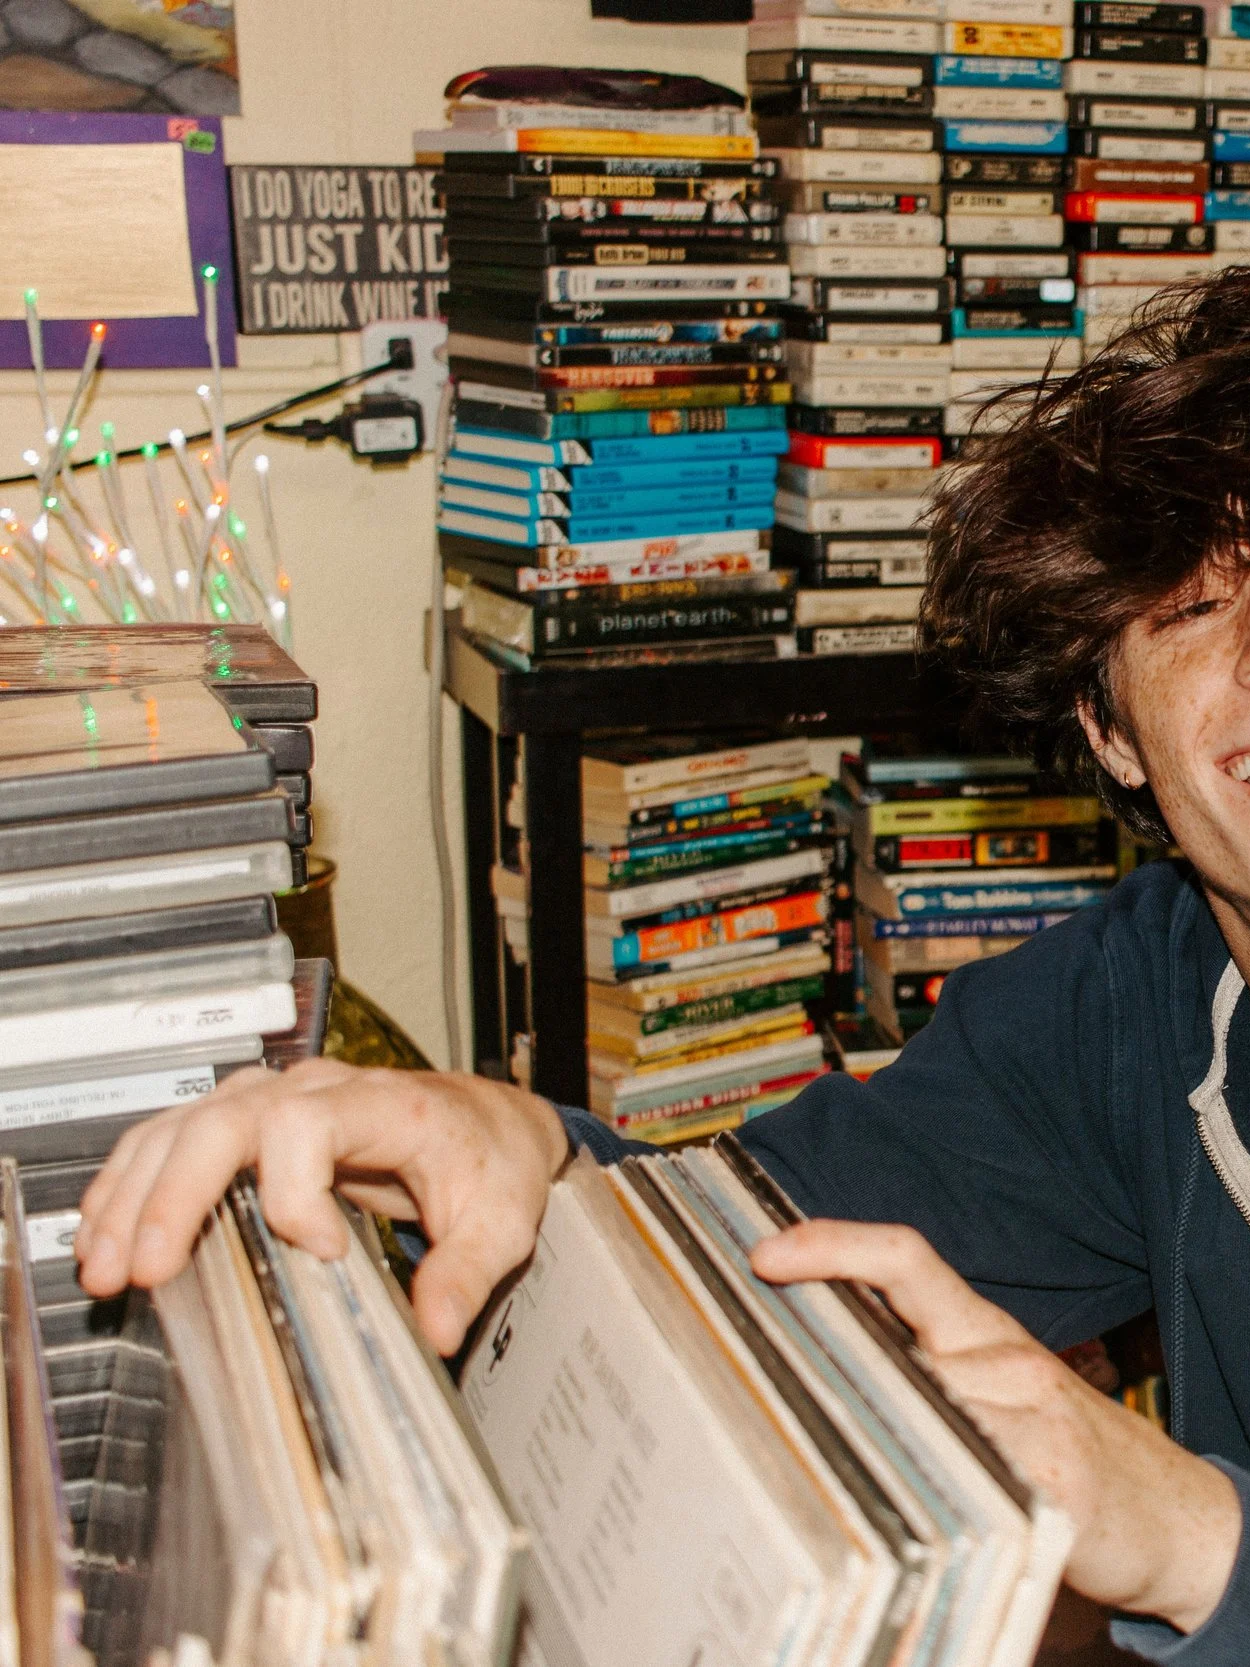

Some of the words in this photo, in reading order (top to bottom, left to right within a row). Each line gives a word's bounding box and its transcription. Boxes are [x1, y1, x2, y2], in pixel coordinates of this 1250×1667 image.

[241, 171, 252, 219] I
[256, 170, 293, 220] DO
[296, 170, 366, 220] YOGA
[368, 170, 402, 220] TO
[405, 170, 447, 219] RE
[251, 223, 364, 275] JUST
[253, 282, 265, 328] I
[268, 281, 349, 329] DRINK
[351, 281, 420, 326] WINE
[600, 609, 668, 634] planet
[673, 606, 732, 629] earth
[174, 1078, 215, 1097] DVD
